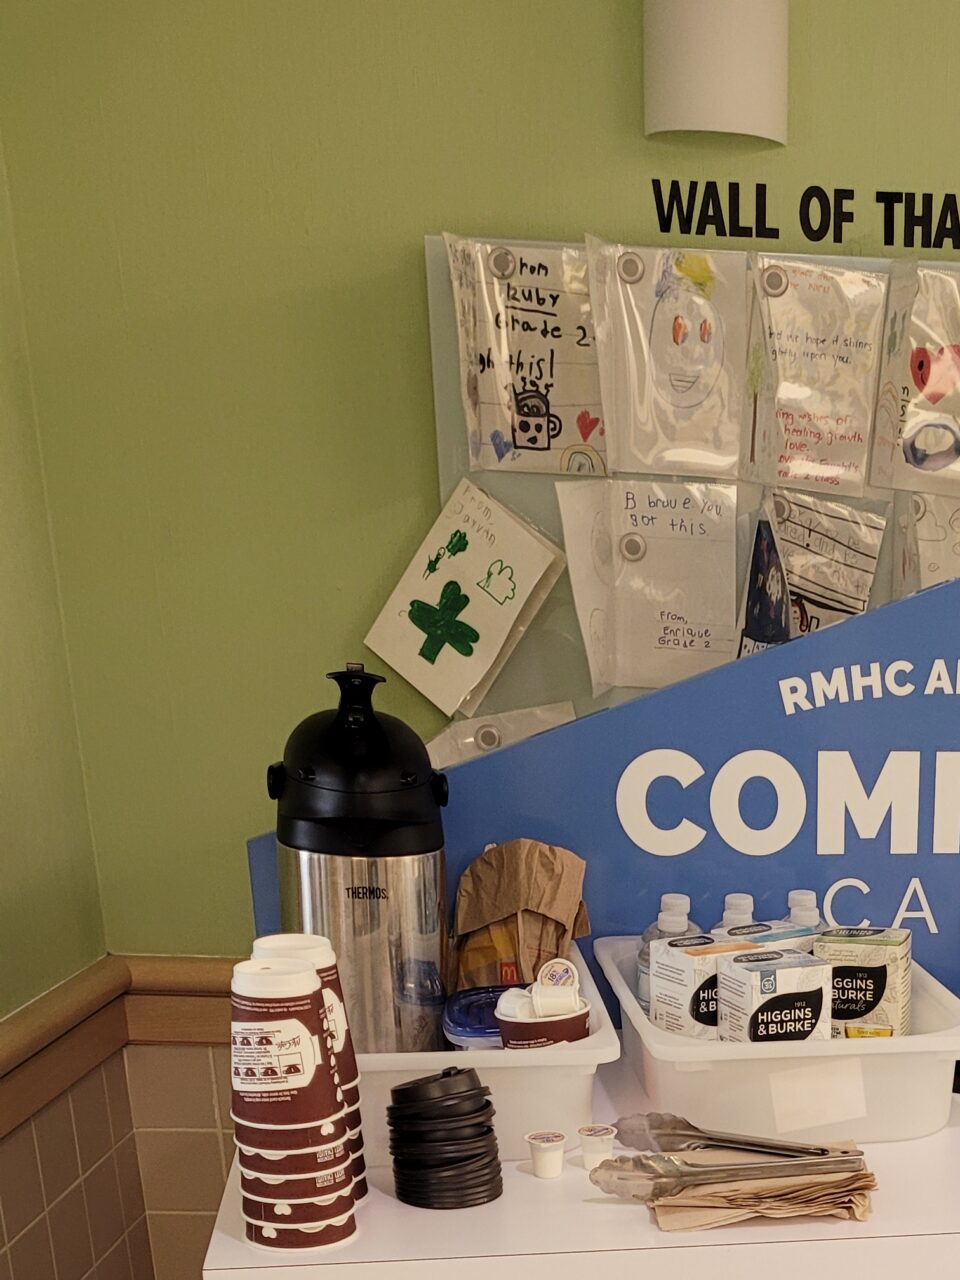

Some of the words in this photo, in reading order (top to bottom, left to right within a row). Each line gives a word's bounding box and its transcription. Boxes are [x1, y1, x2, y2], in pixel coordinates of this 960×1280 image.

[652, 179, 779, 239] WALL
[800, 185, 855, 244] OF
[519, 257, 549, 277] rom
[624, 491, 637, 510] B
[630, 514, 657, 527] got
[778, 659, 916, 716] RMHC
[833, 977, 874, 990] GGINS
[757, 1007, 813, 1023] HIGGINS
[757, 1025, 767, 1036] &
[768, 1020, 812, 1034] BURKE
